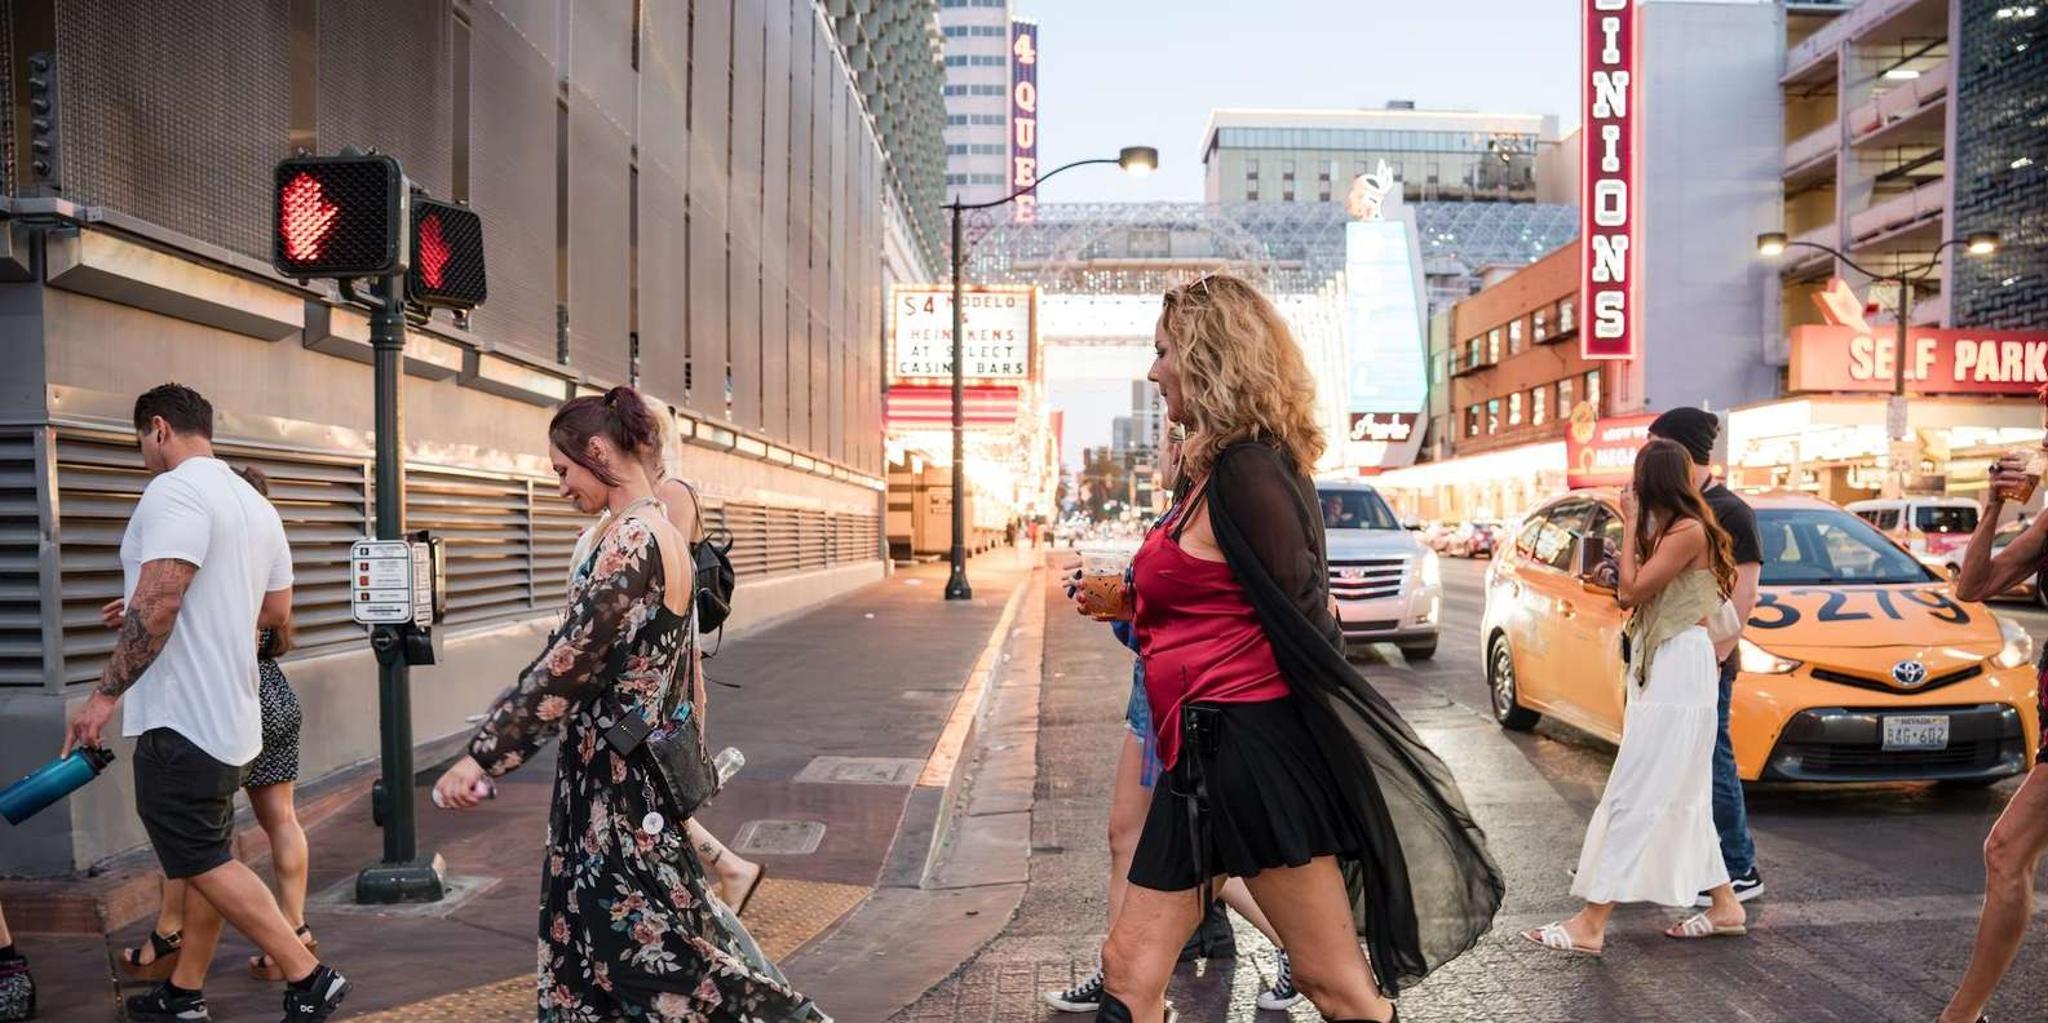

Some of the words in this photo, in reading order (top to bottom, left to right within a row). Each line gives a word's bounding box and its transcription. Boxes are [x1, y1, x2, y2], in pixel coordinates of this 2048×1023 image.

[1014, 34, 1035, 65] 4
[1592, 0, 1629, 338] INIONS
[911, 329, 1015, 341] HEINKENS
[911, 346, 929, 357] AT
[946, 346, 1014, 357] SLECT
[1954, 338, 2048, 382] PARK
[900, 362, 954, 373] CASIN
[977, 362, 1024, 374] BARS
[1747, 588, 1971, 629] 3279
[300, 1004, 315, 1013] DC
